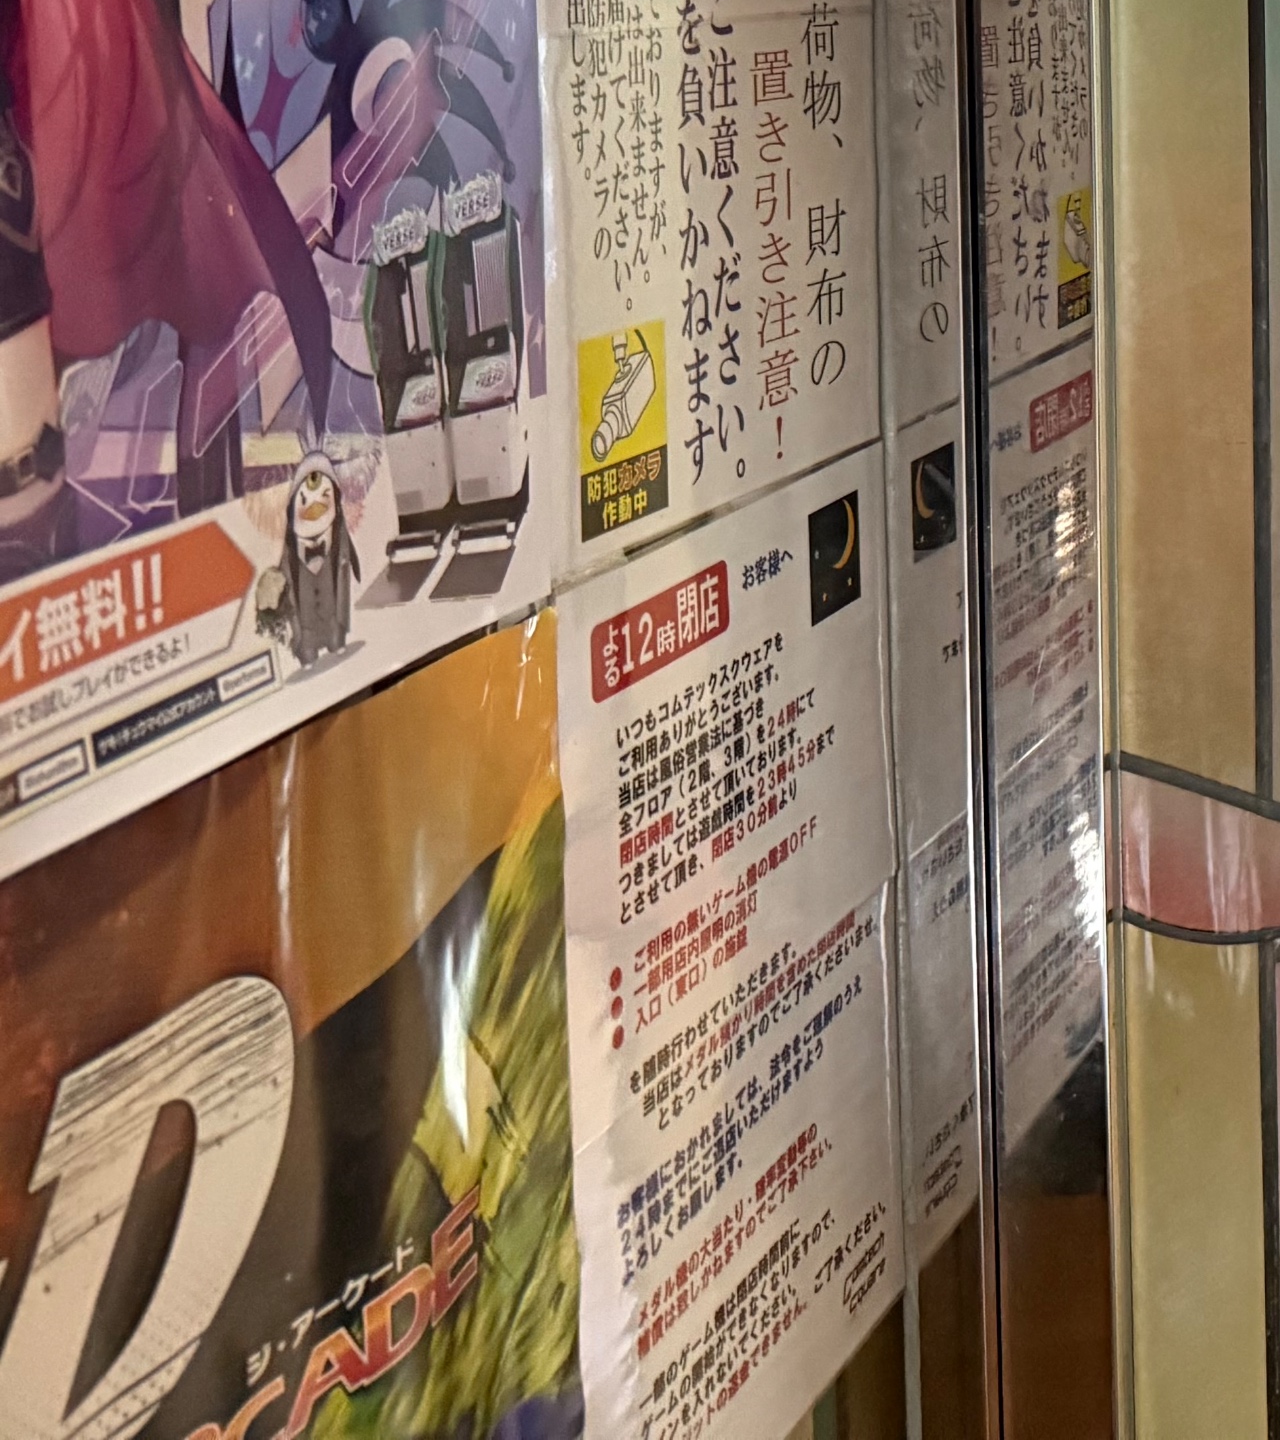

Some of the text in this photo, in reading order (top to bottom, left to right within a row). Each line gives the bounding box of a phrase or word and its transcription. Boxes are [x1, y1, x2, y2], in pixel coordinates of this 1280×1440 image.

[749, 49, 800, 460] 置き引き注意！
[586, 450, 661, 505] 防犯カメラ
[602, 494, 648, 530] 作動中
[741, 548, 794, 592] お客様へ
[616, 632, 784, 749] いつもコムテックスクウェアを
[618, 664, 780, 777] ご利用ありがとうございます。
[618, 697, 765, 810] 当店は風俗営業法に基づき
[620, 727, 802, 868] 閉店時間とさせて頂いております。
[629, 941, 798, 1094] を随時行わせていただきます。
[622, 1152, 743, 1287] よろしくお願いします。
